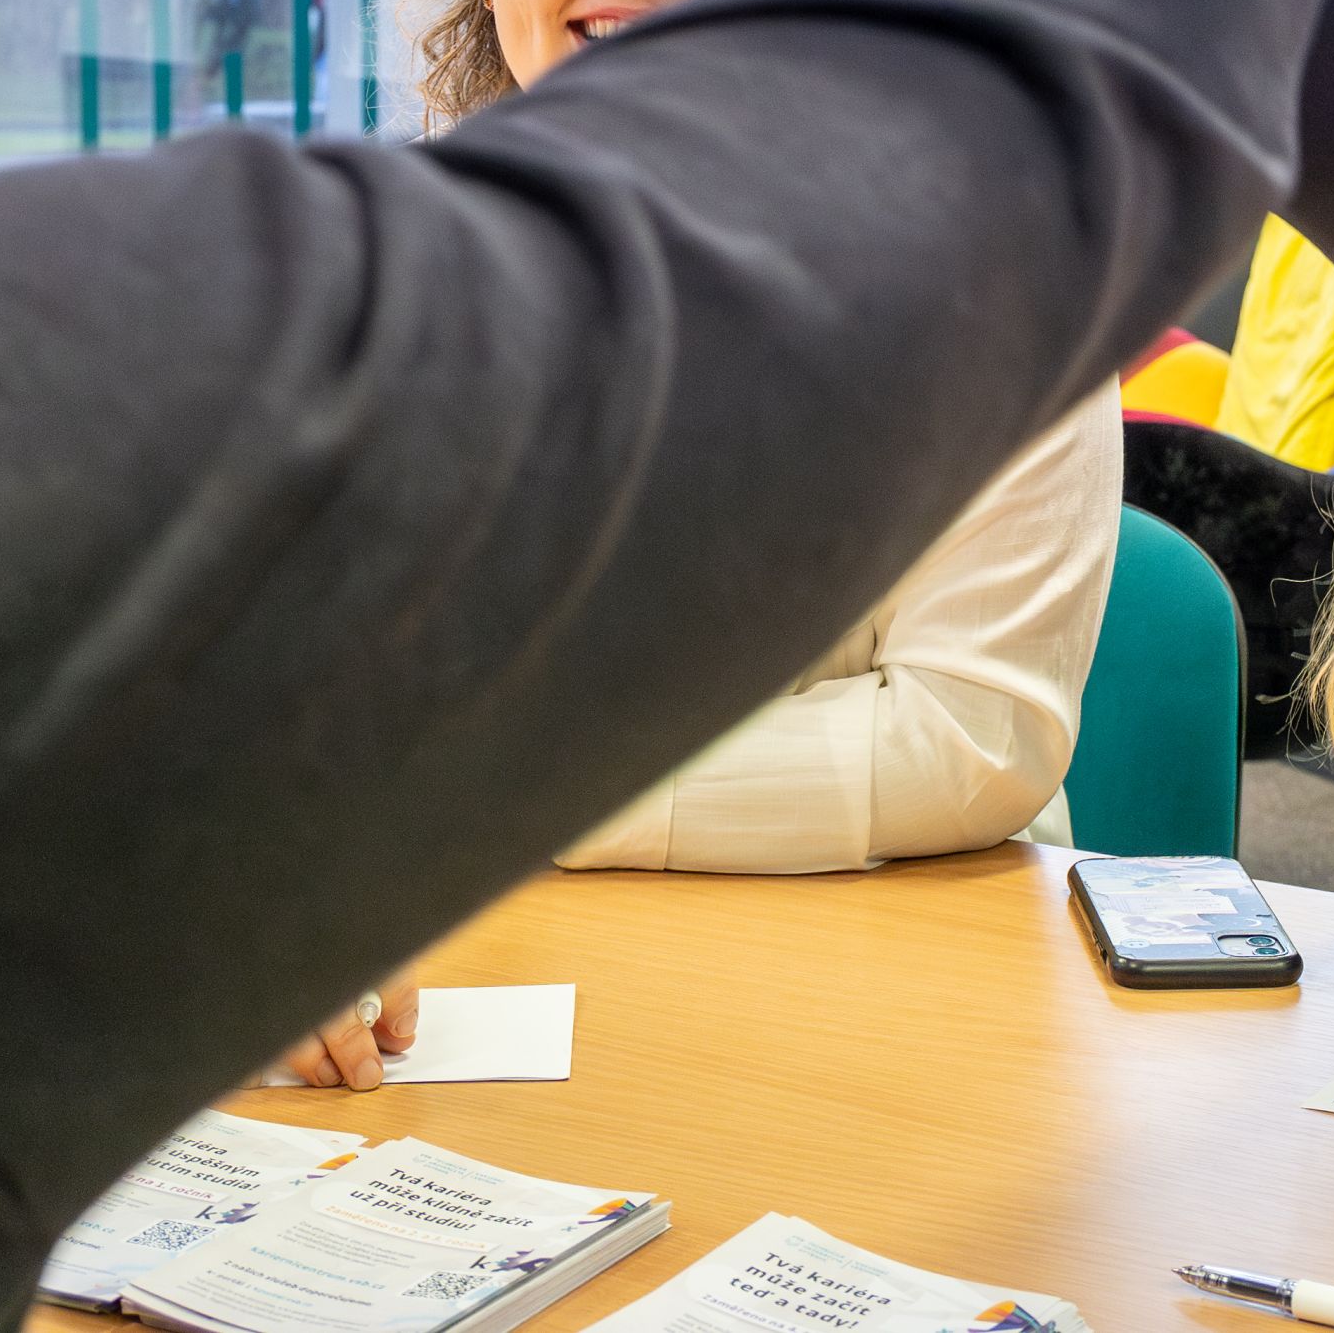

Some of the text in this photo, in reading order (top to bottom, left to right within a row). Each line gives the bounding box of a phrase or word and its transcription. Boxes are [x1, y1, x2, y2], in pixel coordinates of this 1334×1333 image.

[169, 1150, 259, 1177] úspěšným
[192, 1173, 260, 1190] studia!
[369, 1181, 533, 1227] může klidně začít
[390, 1169, 424, 1185] Tvá
[423, 1181, 491, 1205] kariéra
[350, 1191, 475, 1230] už při studiu!
[746, 1267, 869, 1315] může začít
[766, 1253, 803, 1274] Tvá
[807, 1272, 890, 1304] kariéra
[730, 1278, 858, 1328] teď a tady!
